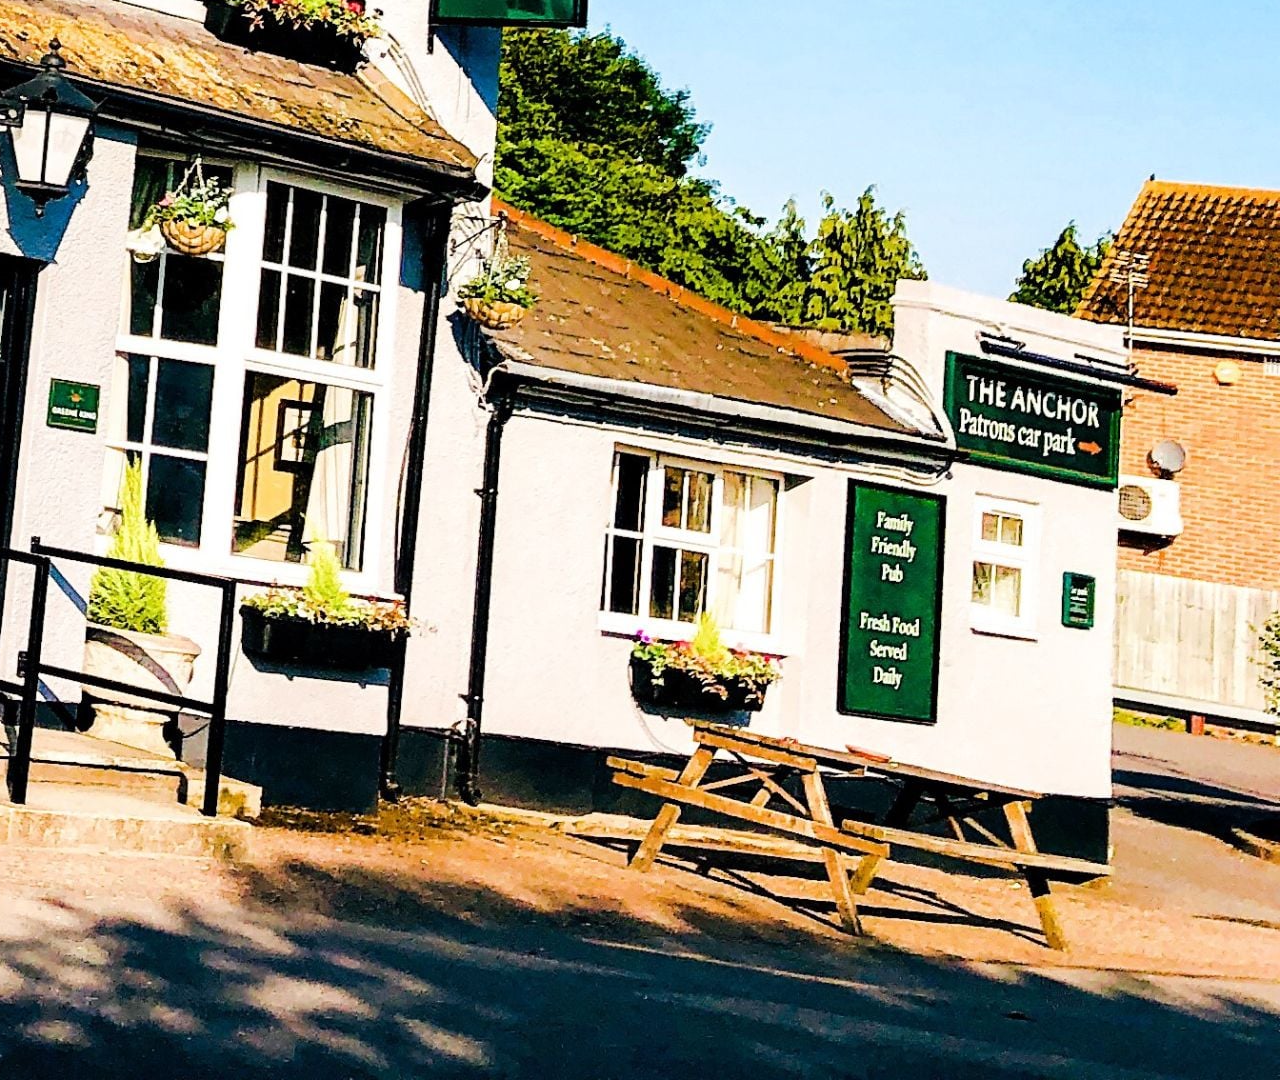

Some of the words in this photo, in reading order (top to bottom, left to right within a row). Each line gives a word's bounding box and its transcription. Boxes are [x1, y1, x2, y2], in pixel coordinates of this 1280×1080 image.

[966, 375, 1007, 408] THE
[1010, 386, 1100, 428] ANCHOR
[958, 407, 1016, 442] Patrons
[1017, 426, 1042, 448] car
[1042, 427, 1076, 457] park
[876, 511, 914, 536] Family
[870, 536, 917, 562] Friendly
[881, 563, 904, 583] Pub
[860, 612, 891, 633] Fresh
[891, 616, 920, 637] Food
[869, 640, 908, 661] Served
[873, 666, 903, 690] Daily
